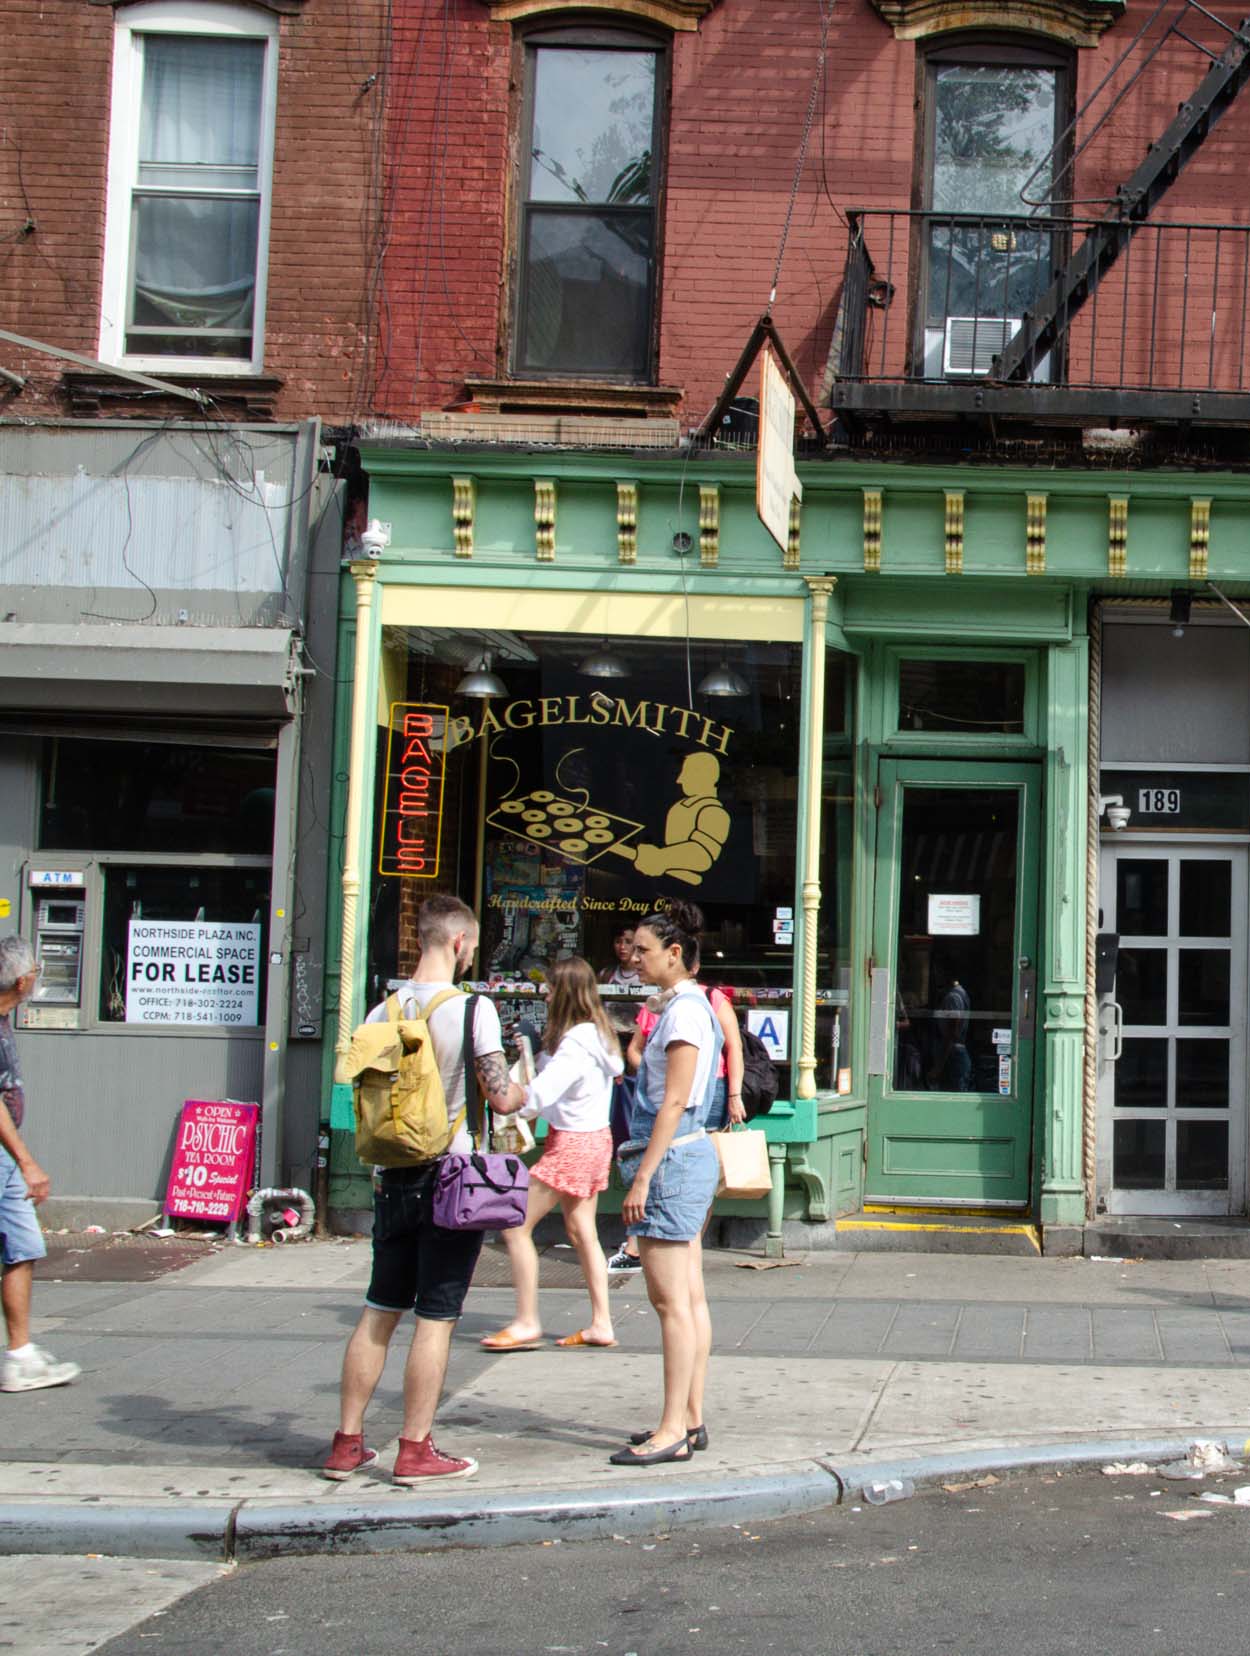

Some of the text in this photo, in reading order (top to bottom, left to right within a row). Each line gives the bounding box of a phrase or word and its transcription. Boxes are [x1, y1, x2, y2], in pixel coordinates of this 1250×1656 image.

[449, 695, 735, 757] BAGELSMITH
[396, 713, 434, 871] BAGELS
[1143, 790, 1178, 812] 189
[43, 873, 73, 883] ATM
[488, 894, 672, 916] Handcrafted Since Day On
[133, 927, 257, 941] NORTHSIDE PLAZA INC.
[133, 945, 255, 960] COMMERCIAL SPACE
[131, 962, 255, 984] FOR LEASE
[138, 997, 243, 1008] OFFICE: 718-302-2224
[143, 1011, 242, 1022] CCPM: 718-541-1009
[758, 1016, 780, 1046] A
[204, 1105, 233, 1118] OPEN
[181, 1121, 247, 1155] PSYCHIC
[185, 1152, 236, 1167] TEA ROOM
[177, 1165, 239, 1187] $10 Special
